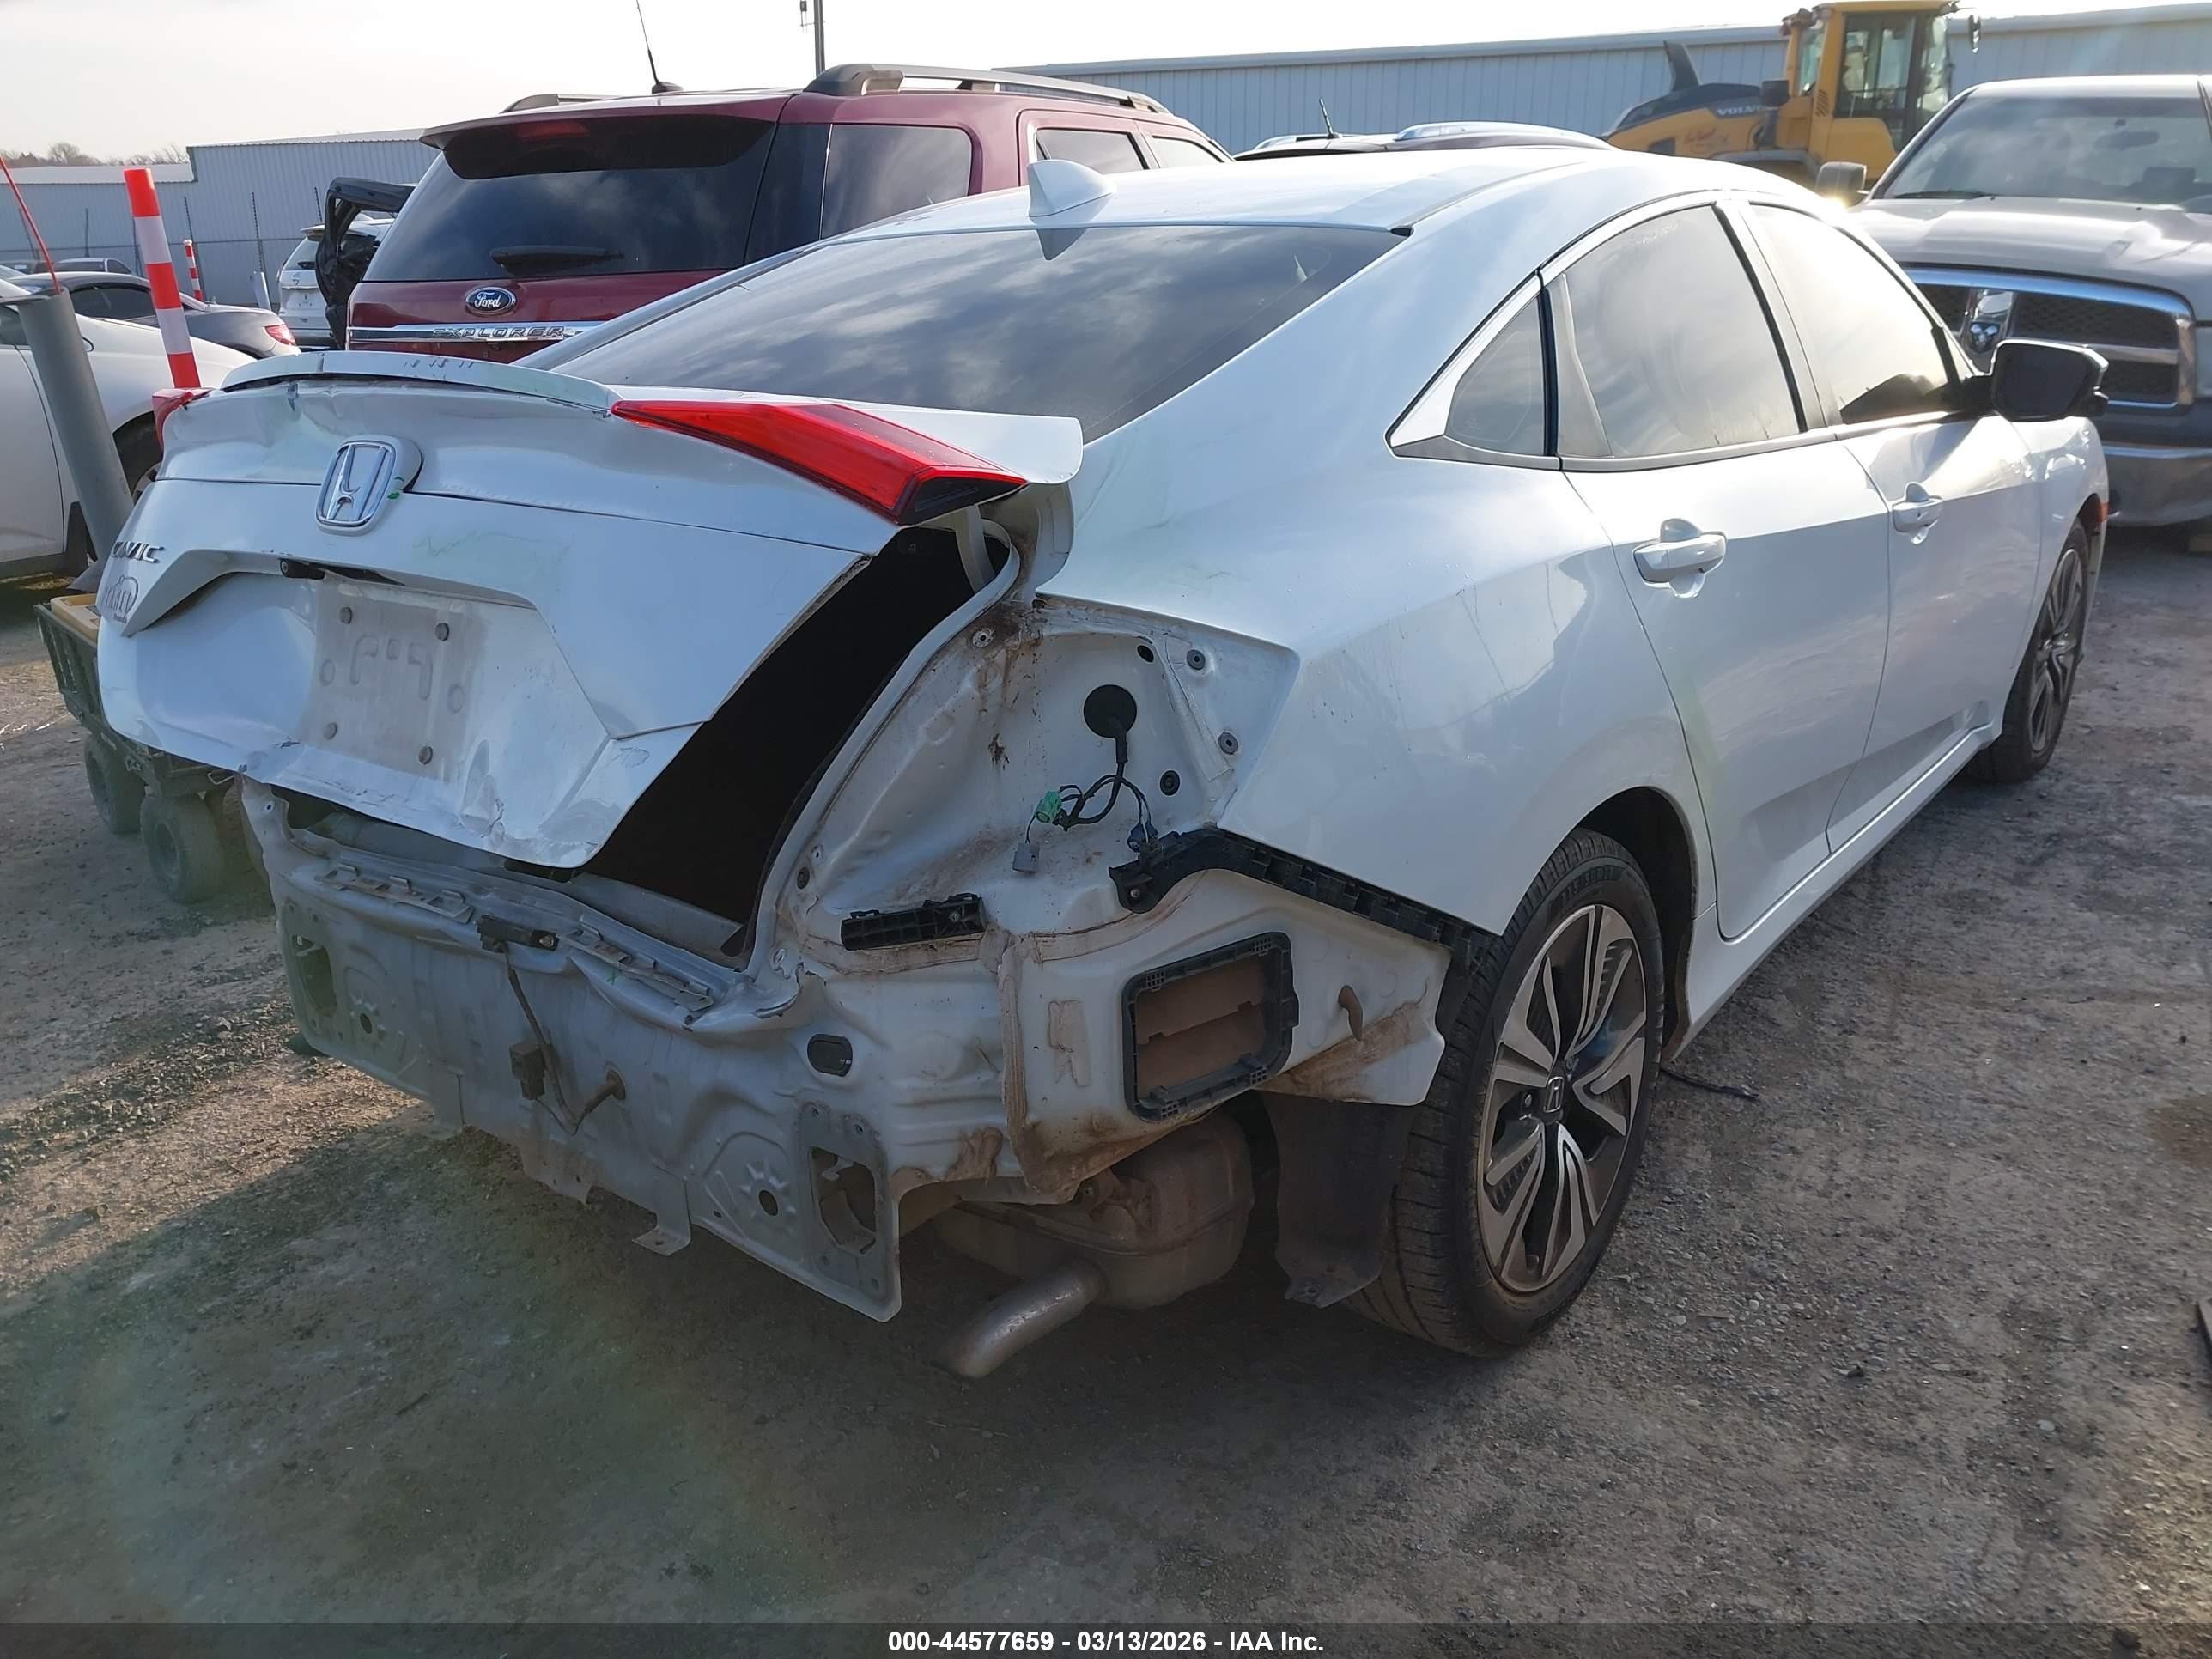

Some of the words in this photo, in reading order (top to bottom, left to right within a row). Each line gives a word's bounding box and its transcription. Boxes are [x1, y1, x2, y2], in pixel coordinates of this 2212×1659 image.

[1717, 104, 1761, 116] VOLV
[474, 291, 501, 308] Ford
[432, 325, 565, 338] EXPLORER
